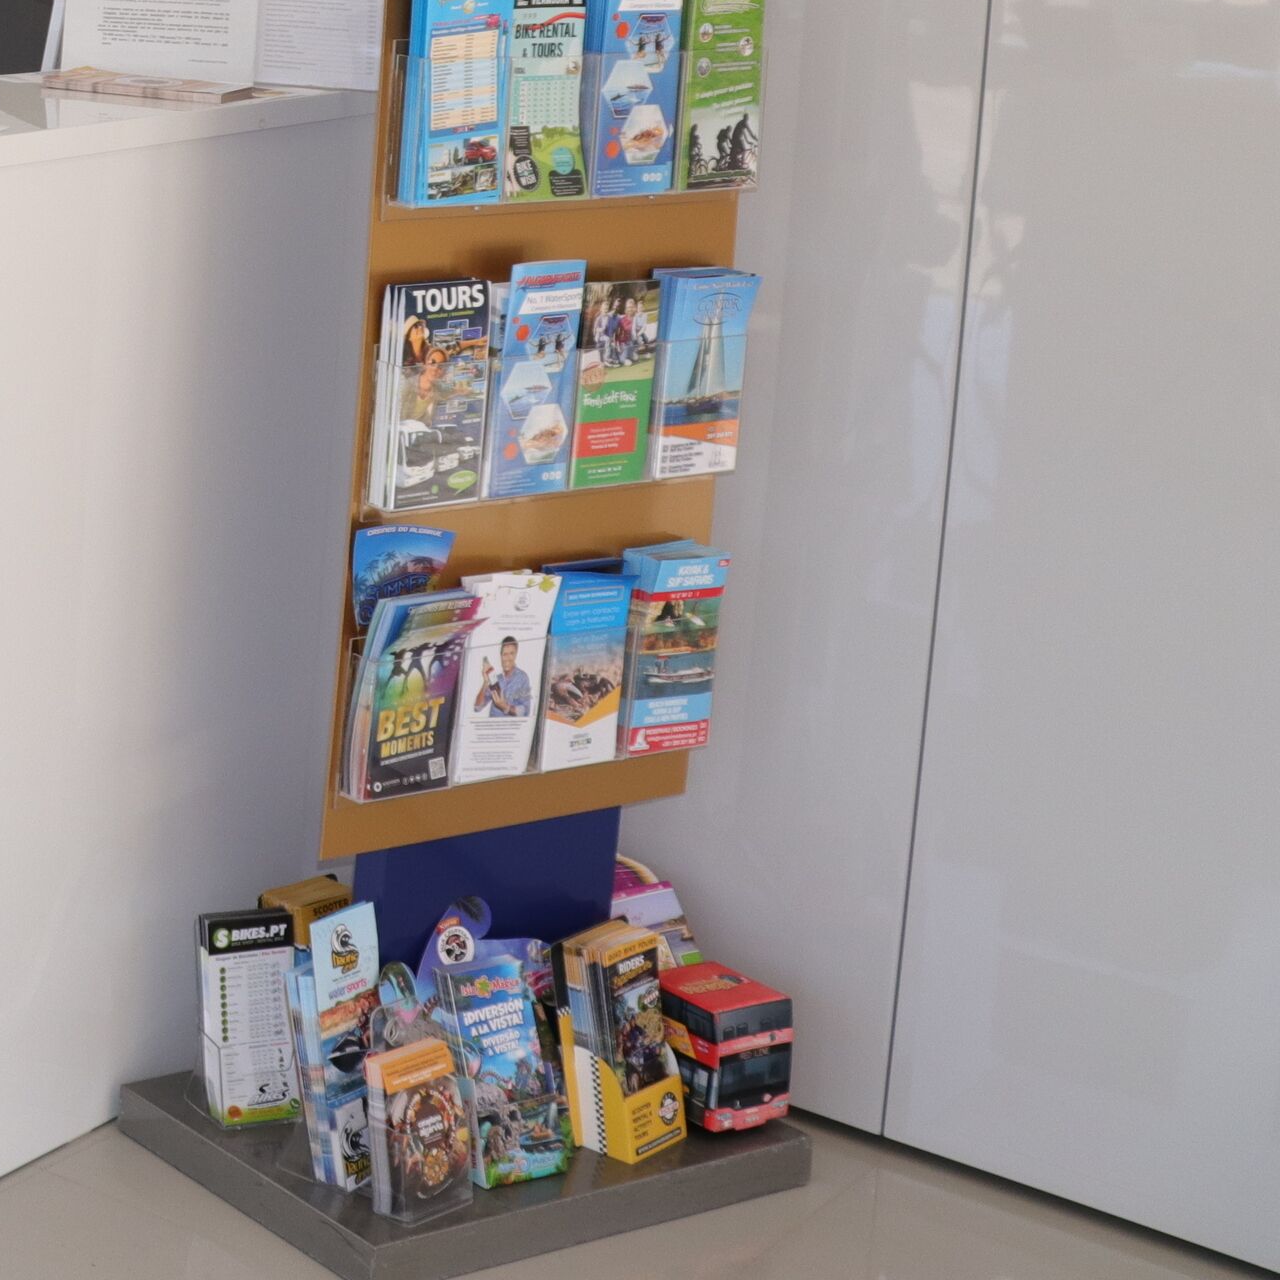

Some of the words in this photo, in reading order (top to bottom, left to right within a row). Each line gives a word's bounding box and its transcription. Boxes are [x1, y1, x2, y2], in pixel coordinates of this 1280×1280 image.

[515, 23, 536, 39] BIKE
[539, 23, 577, 38] RENTAL
[532, 42, 563, 58] TOURS
[413, 284, 485, 313] TOURS
[409, 527, 443, 538] ALGARVE
[377, 696, 445, 742] BEST
[381, 731, 435, 758] MOMENTS
[231, 923, 287, 942] BIKES.PT
[618, 955, 645, 975] RIDERS
[463, 998, 524, 1026] ¡DIVERSIÓN
[471, 1026, 479, 1037] A
[479, 1023, 490, 1035] LA
[490, 1012, 524, 1032] VISTA!
